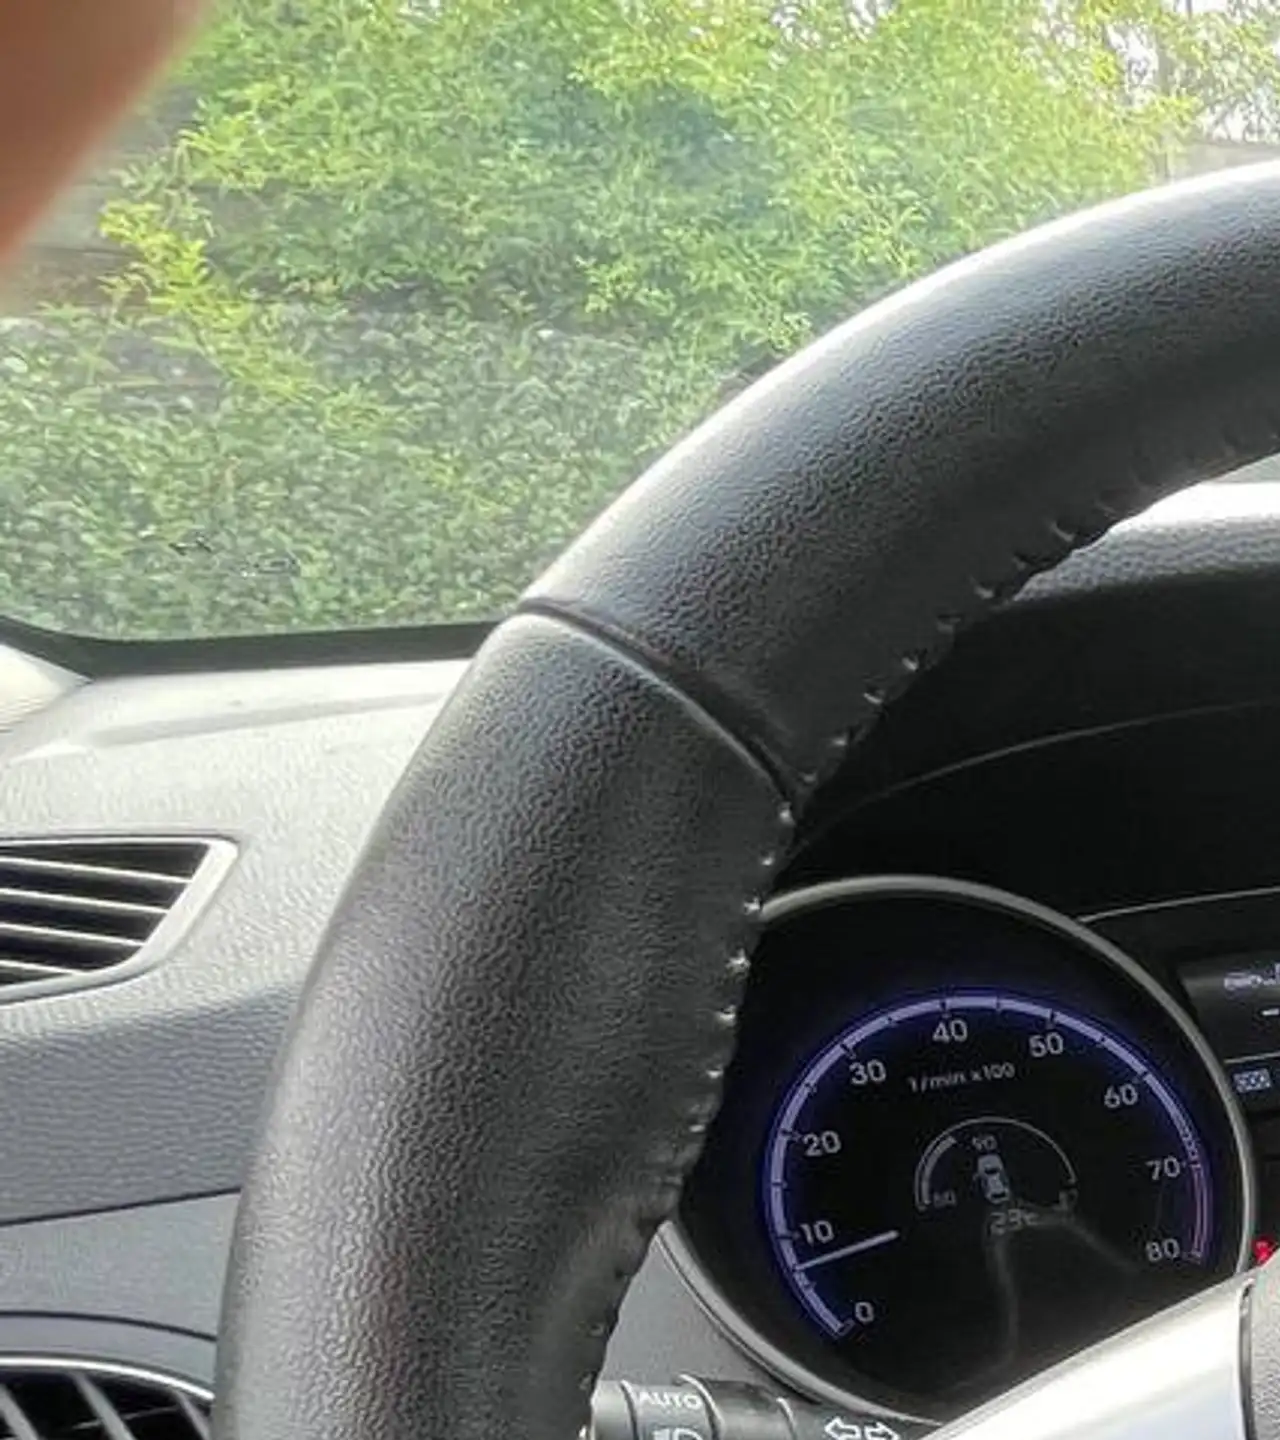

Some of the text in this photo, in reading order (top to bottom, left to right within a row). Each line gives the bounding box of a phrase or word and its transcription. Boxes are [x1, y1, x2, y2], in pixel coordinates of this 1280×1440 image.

[932, 1019, 968, 1044] 40
[1029, 1034, 1064, 1057] 50
[848, 1060, 886, 1086] 30
[908, 1070, 966, 1092] 1/min
[1103, 1083, 1139, 1109] 60
[803, 1131, 842, 1157] 20
[1146, 1156, 1181, 1180] 70
[801, 1221, 834, 1245] 10
[1146, 1239, 1181, 1264] 80
[855, 1302, 874, 1324] 0
[638, 1391, 703, 1410] AUTO
